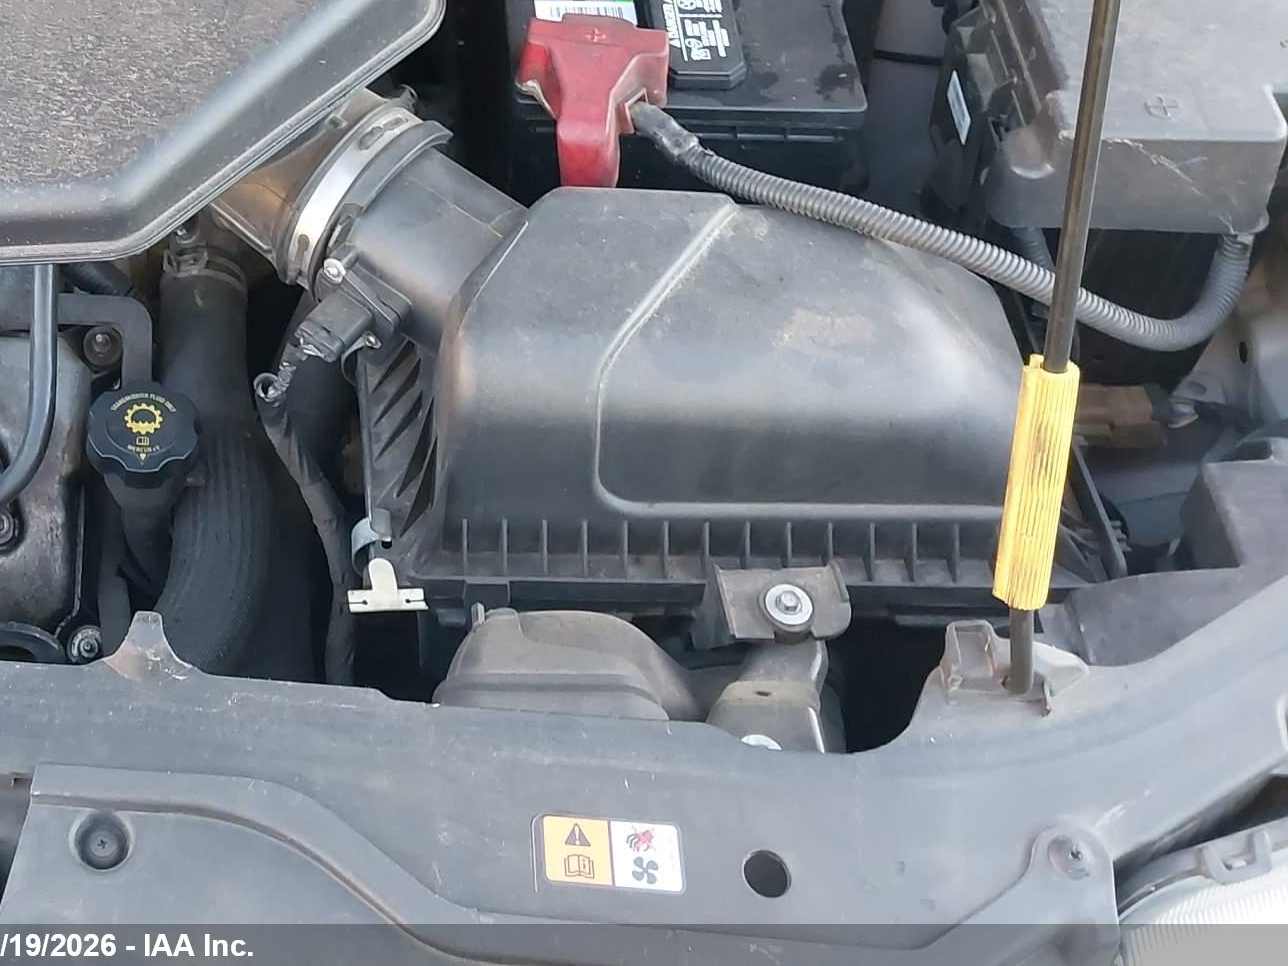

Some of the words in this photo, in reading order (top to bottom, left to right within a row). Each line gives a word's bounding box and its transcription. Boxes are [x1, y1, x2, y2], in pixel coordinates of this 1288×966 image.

[110, 393, 149, 411] TRANSMISSION
[149, 393, 166, 404] FLUID
[164, 400, 177, 412] ONLY
